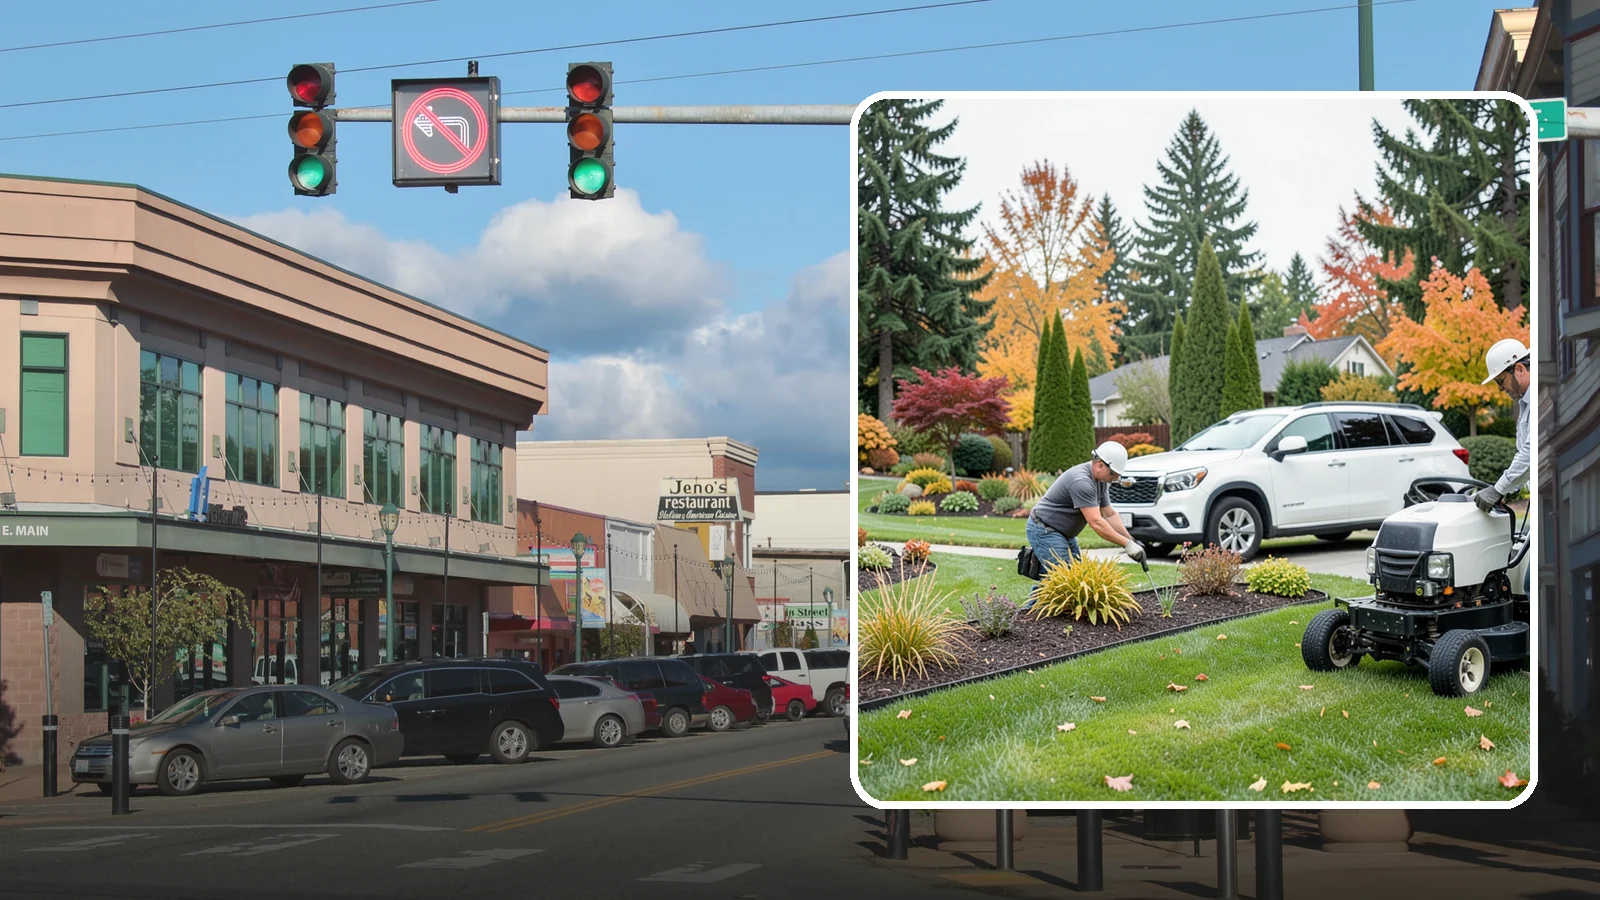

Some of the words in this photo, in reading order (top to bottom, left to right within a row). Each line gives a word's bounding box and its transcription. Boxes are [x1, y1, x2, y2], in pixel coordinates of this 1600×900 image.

[670, 480, 727, 494] Jeno's
[665, 496, 731, 509] restaurant
[659, 510, 681, 519] Italian
[686, 510, 714, 519] American
[715, 509, 737, 519] Cuisine
[2, 525, 13, 536] E.
[15, 525, 49, 536] MAIN
[797, 607, 829, 617] Street
[791, 619, 824, 627] lass
